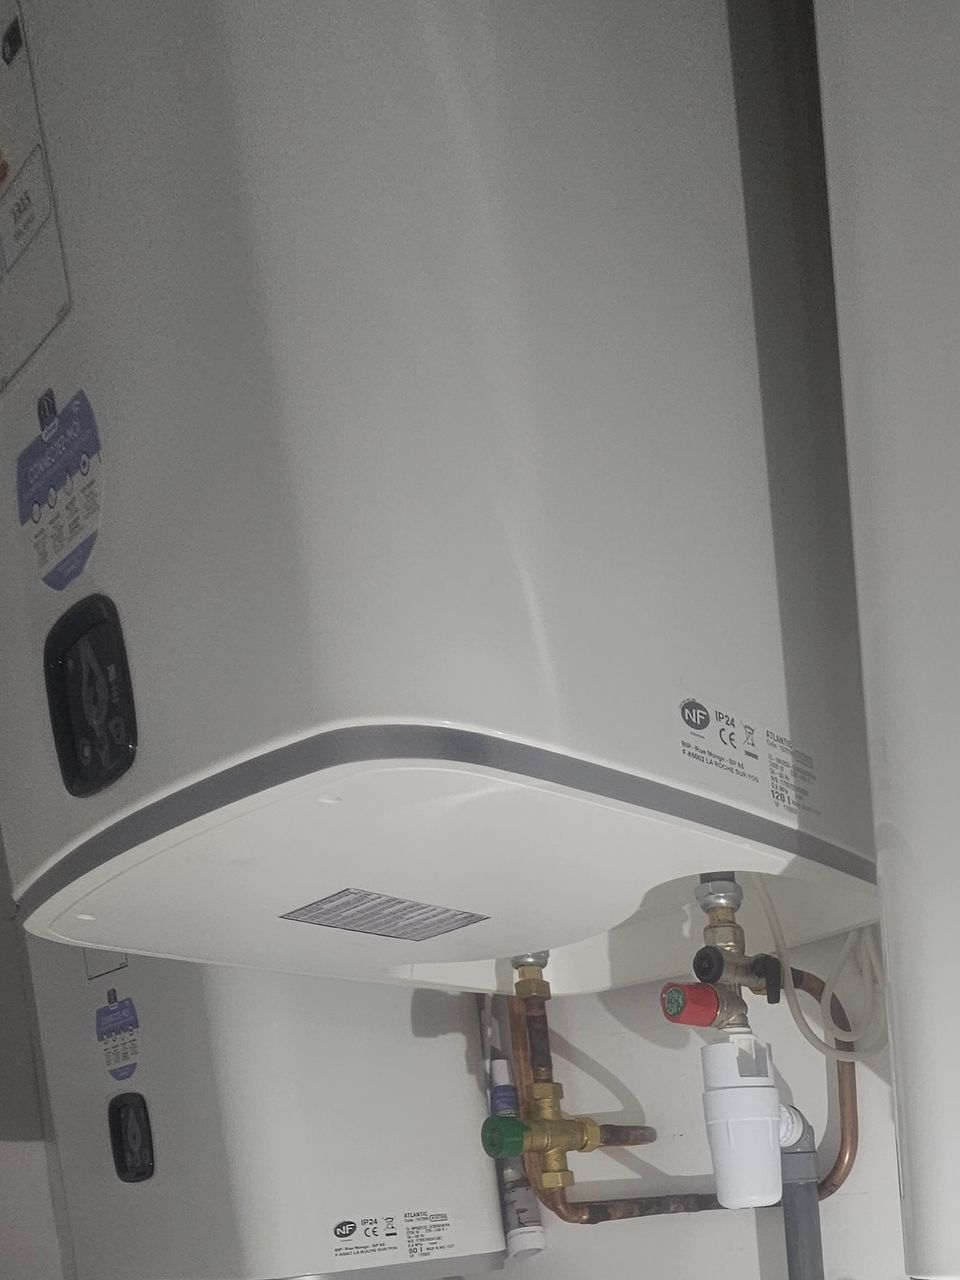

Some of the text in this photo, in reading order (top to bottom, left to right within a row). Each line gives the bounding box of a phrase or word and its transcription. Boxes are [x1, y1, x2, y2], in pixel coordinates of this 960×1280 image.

[684, 708, 707, 725] NF
[715, 710, 735, 728] IP24
[719, 728, 736, 749] CE
[771, 789, 785, 802] 120
[360, 1218, 378, 1226] IP24
[336, 1223, 354, 1235] NF
[364, 1226, 379, 1237] CE
